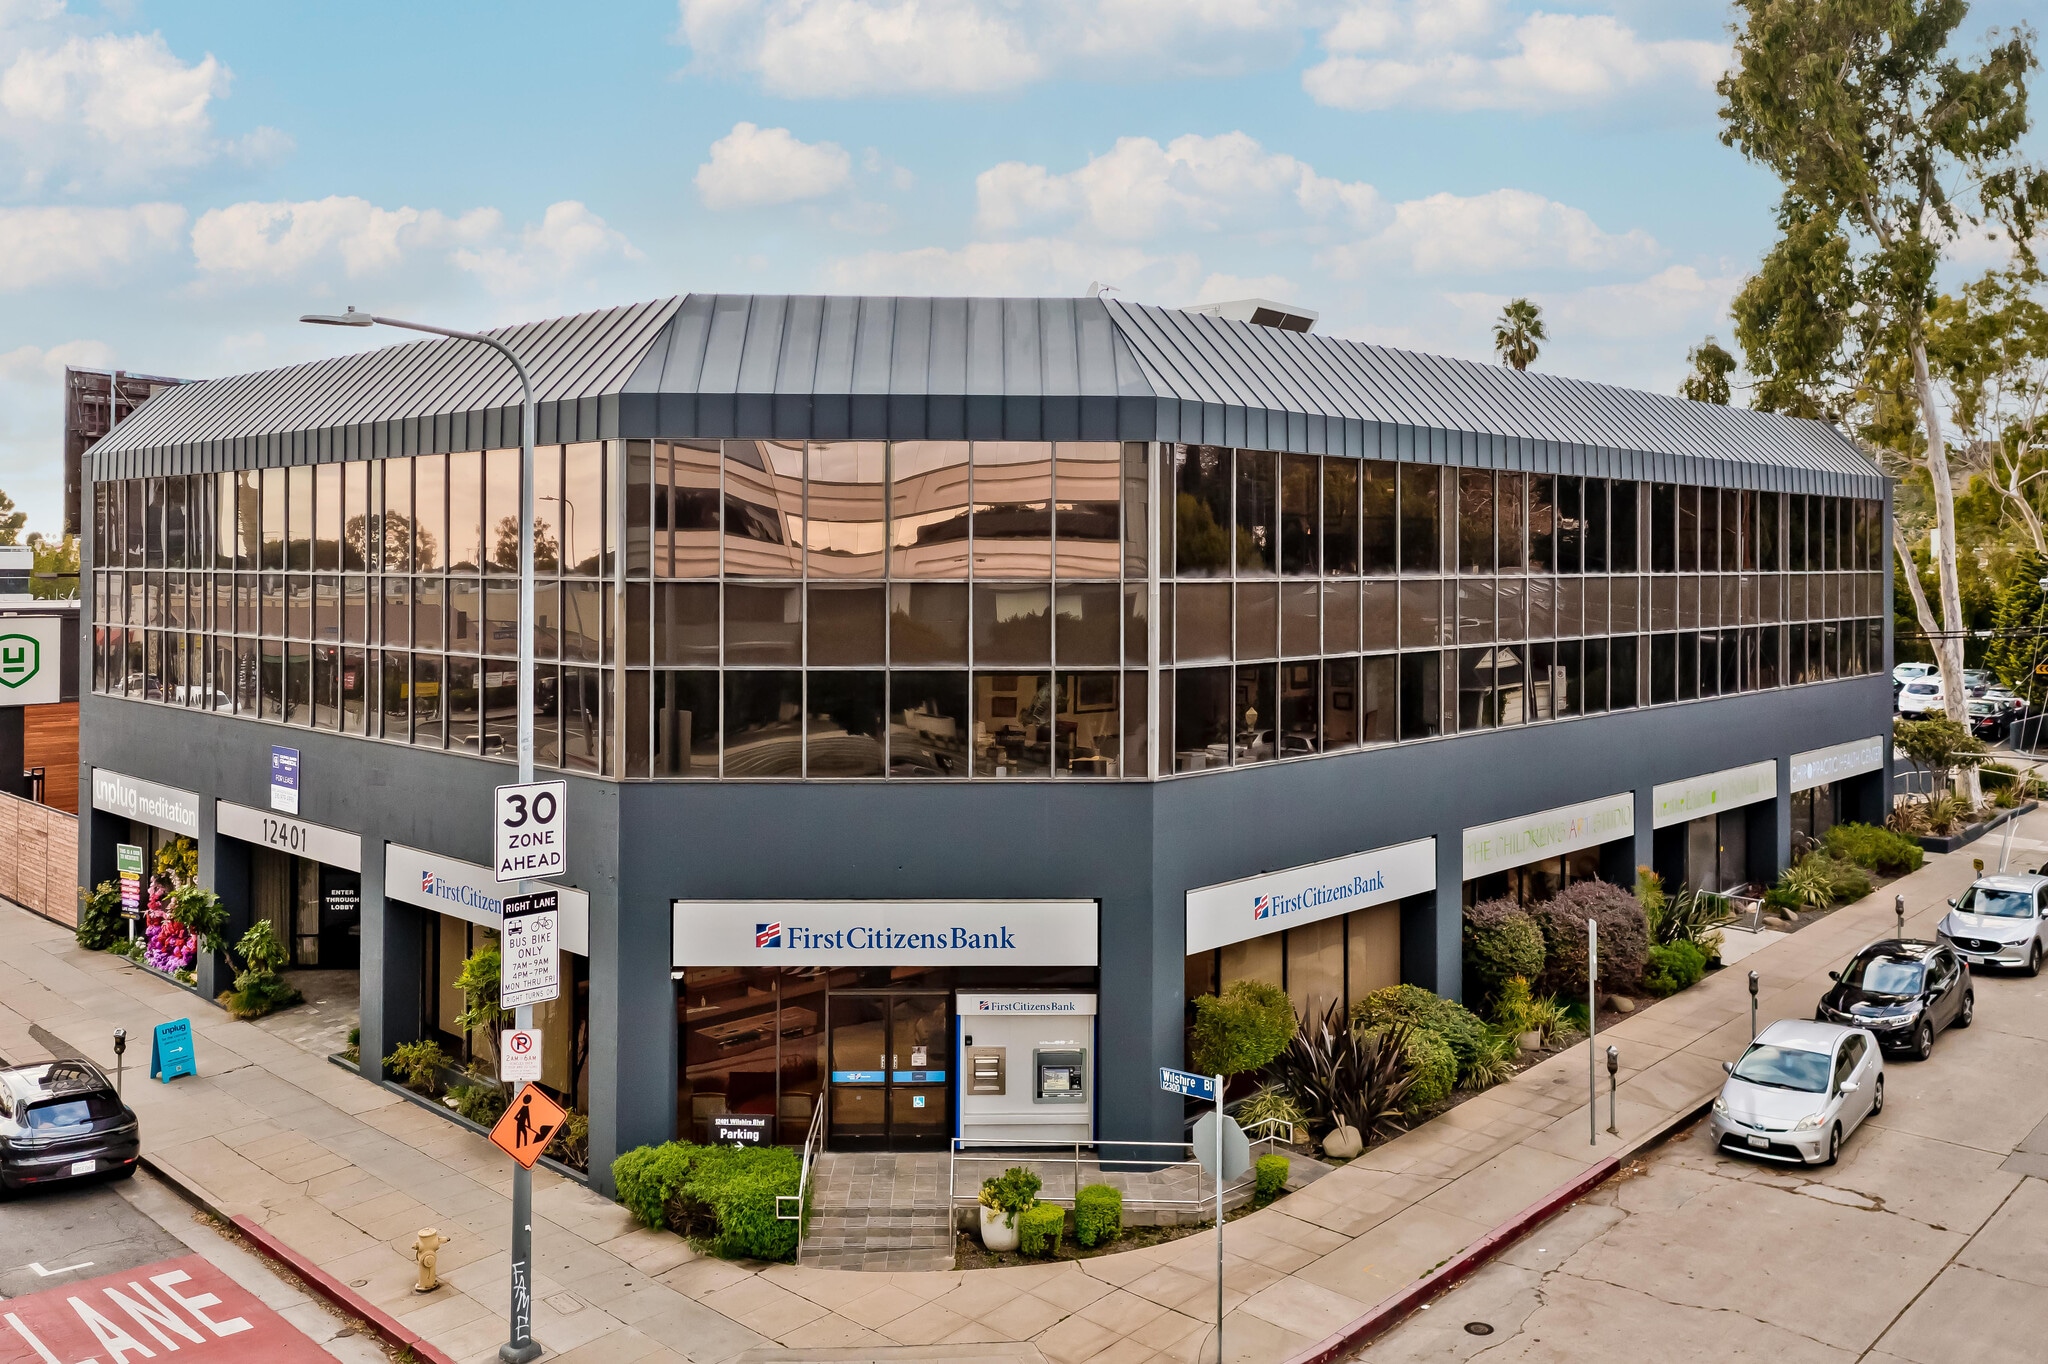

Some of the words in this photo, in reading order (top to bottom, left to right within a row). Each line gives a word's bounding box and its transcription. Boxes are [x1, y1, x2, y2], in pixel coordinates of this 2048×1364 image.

[275, 774, 283, 782] FOR
[283, 776, 294, 785] LEASE
[95, 778, 137, 816] unplug
[139, 796, 195, 827] meditation
[503, 791, 557, 828] 30
[263, 818, 306, 852] 12401
[509, 830, 554, 849] ZONE
[1466, 839, 1491, 864] THE
[1568, 816, 1590, 840] ART
[1593, 805, 1631, 833] STUDIO
[501, 852, 561, 873] AHEAD
[436, 877, 502, 915] FirstCitizen
[1272, 870, 1385, 917] FirstCitizensBank
[505, 900, 531, 914] RIGHT
[534, 896, 556, 909] LANE
[509, 936, 527, 949] BUS
[531, 932, 551, 945] BIKE
[787, 926, 1016, 949] FirstCitizensBank
[518, 945, 543, 959] ONLY
[505, 982, 520, 992] MON
[523, 977, 541, 988] THRU
[545, 974, 555, 983] FRI
[506, 994, 523, 1003] RIGHT
[525, 990, 544, 1000] TURNS
[991, 1002, 1075, 1011] FirstCitizensBank
[162, 1024, 186, 1035] unplug
[1162, 1080, 1180, 1092] 12300
[1182, 1086, 1188, 1094] W
[1163, 1070, 1196, 1088] Wilshire
[1204, 1080, 1213, 1092] Bl
[730, 1118, 752, 1126] Wilshire
[753, 1119, 765, 1127] Blvd
[720, 1128, 760, 1142] Parking
[3, 1269, 254, 1364] LANE
